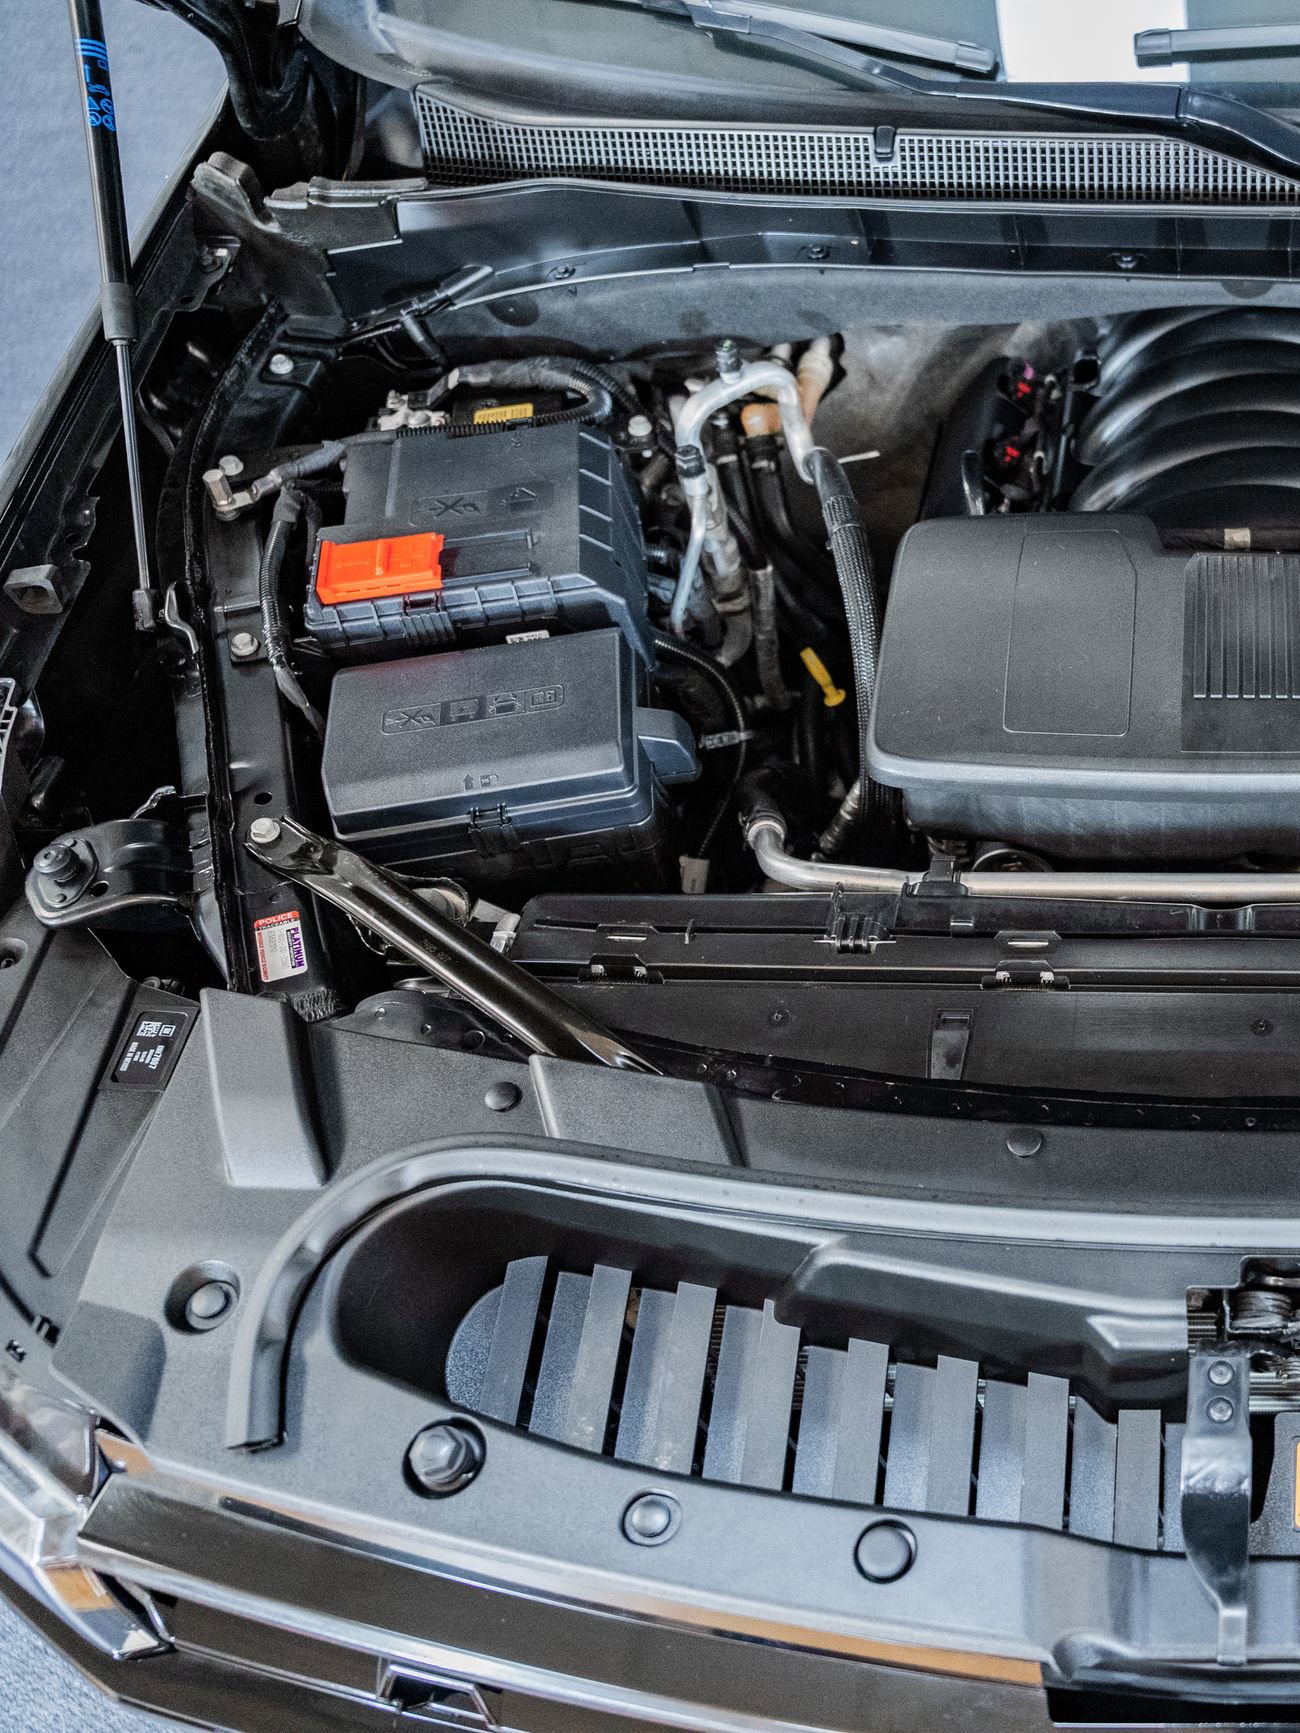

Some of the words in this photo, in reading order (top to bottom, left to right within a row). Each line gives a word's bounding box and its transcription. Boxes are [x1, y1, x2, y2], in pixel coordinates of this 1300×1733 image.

[259, 912, 294, 926] POLICE
[259, 918, 295, 930] TRACEABLE
[290, 926, 305, 968] PLATINUM
